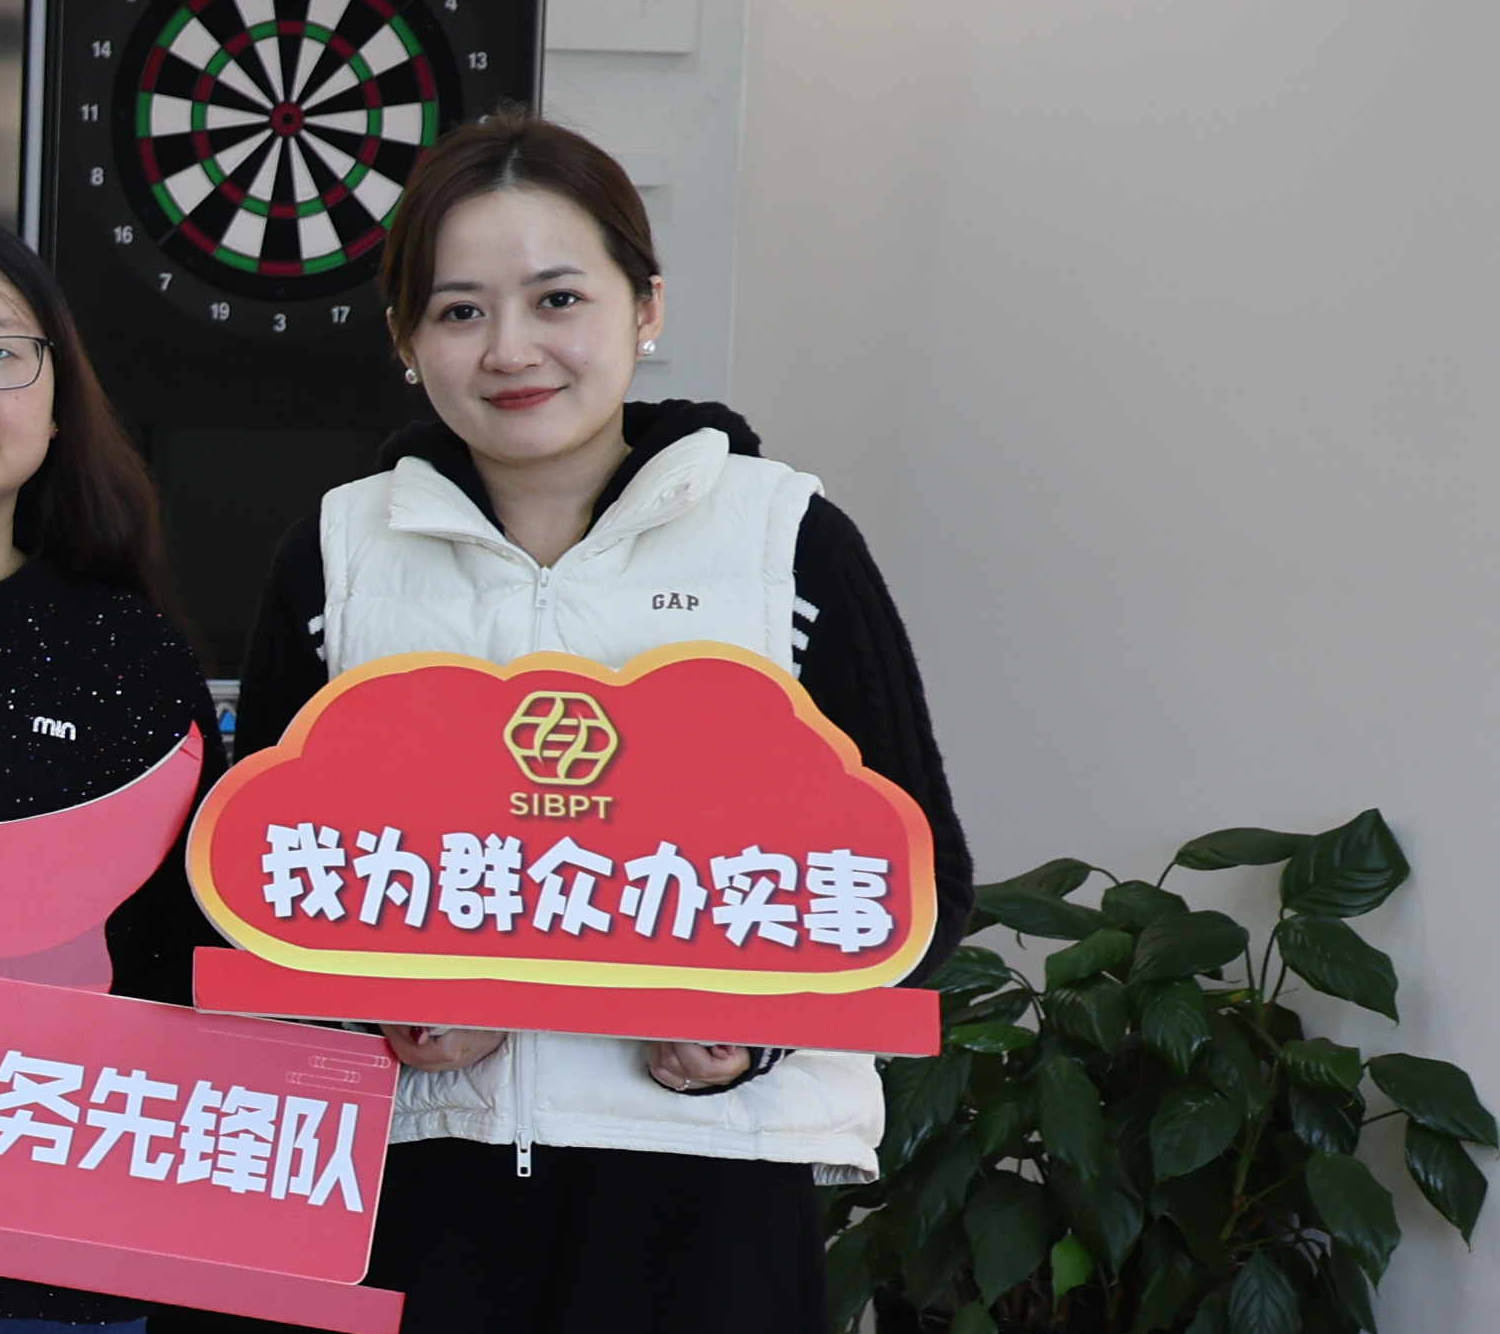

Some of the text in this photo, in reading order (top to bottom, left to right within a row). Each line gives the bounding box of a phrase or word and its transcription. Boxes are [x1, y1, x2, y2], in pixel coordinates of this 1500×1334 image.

[92, 40, 112, 57] 14
[468, 52, 488, 69] 13
[80, 104, 99, 120] 11
[90, 167, 104, 185] 8
[114, 226, 133, 243] 16
[159, 273, 173, 291] 7
[210, 303, 230, 320] 19
[331, 306, 351, 323] 17
[274, 314, 286, 331] 3
[652, 592, 699, 611] GAP
[509, 791, 613, 820] SIBPT
[261, 822, 893, 954] 我为群众办实事
